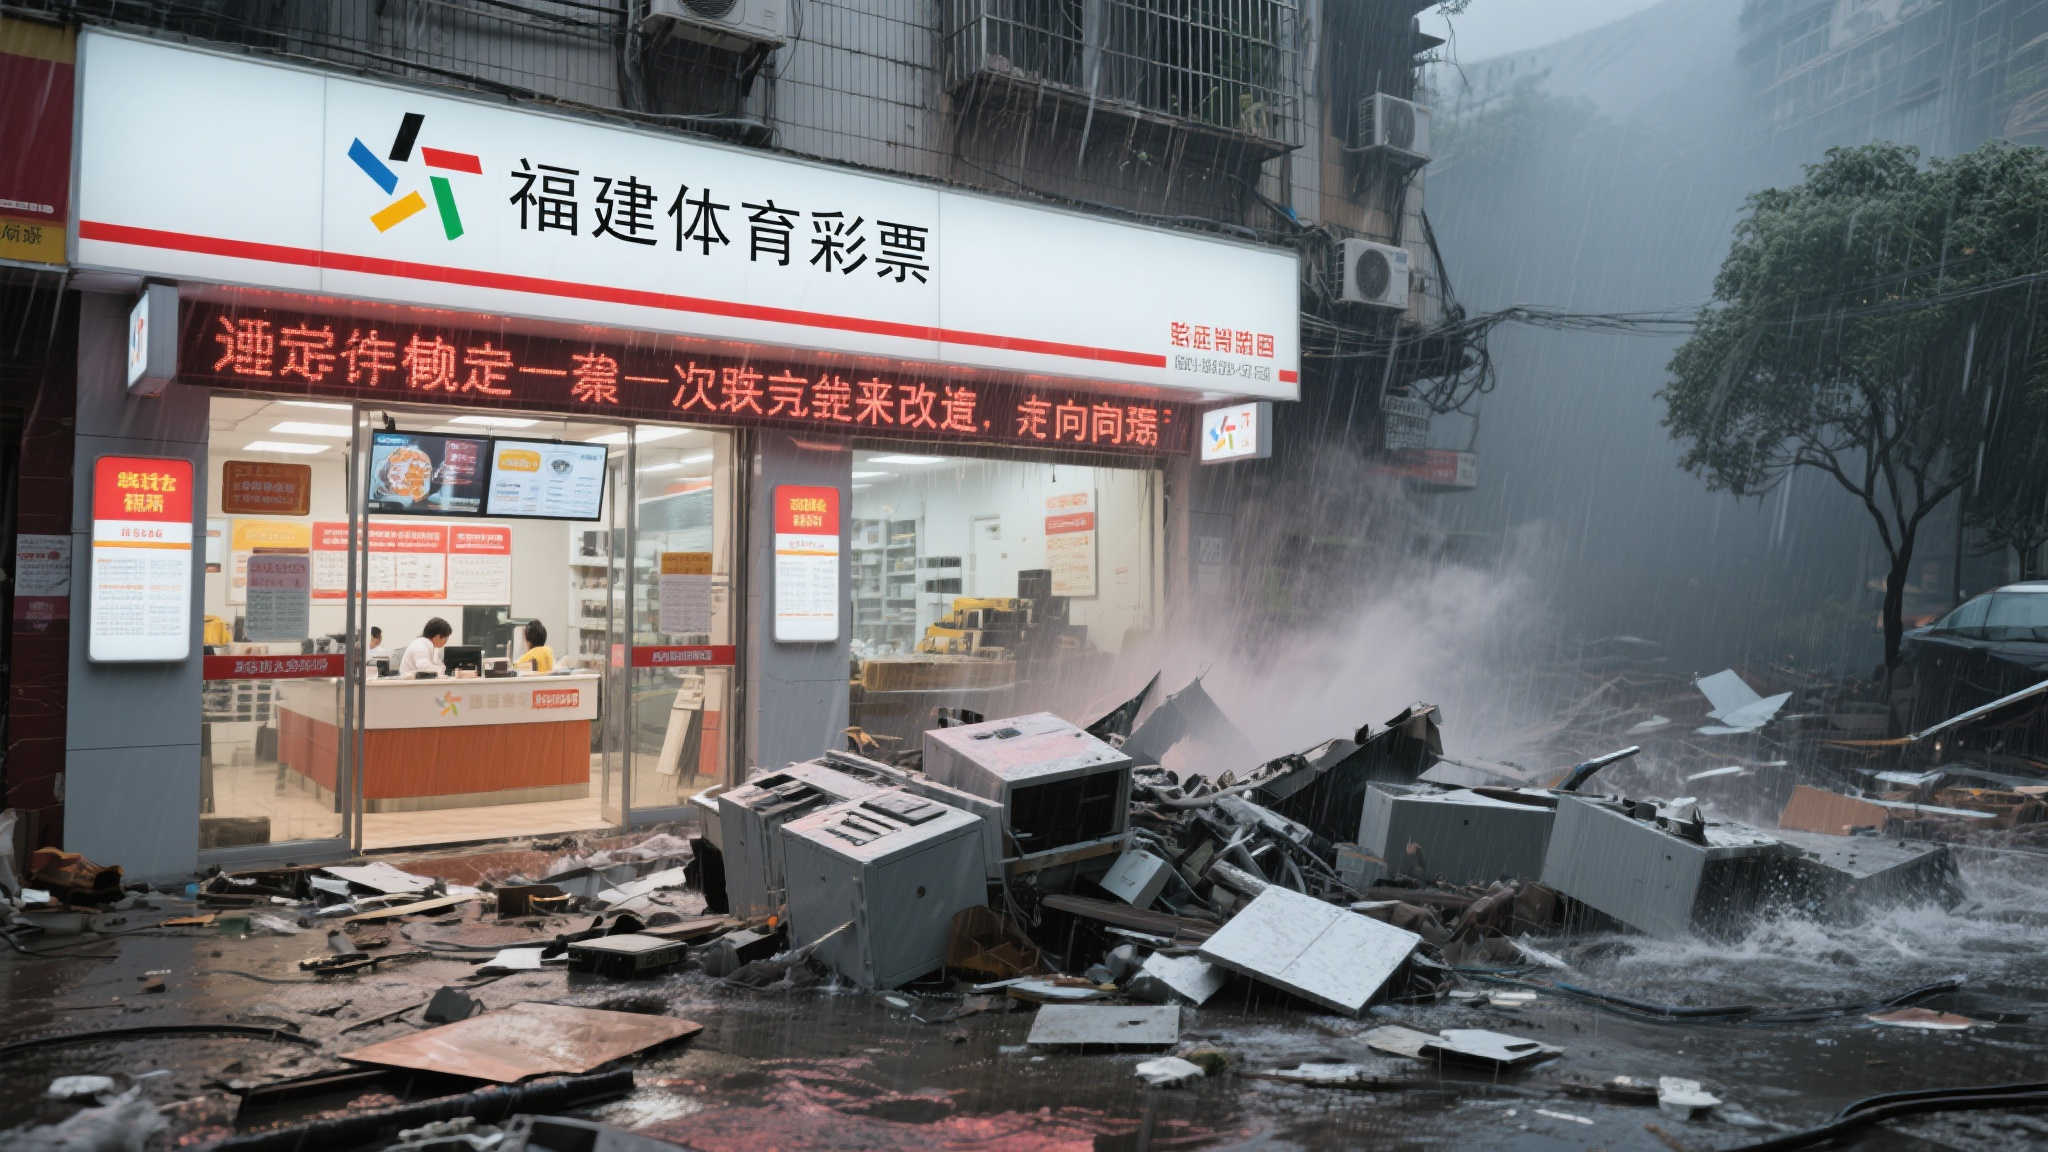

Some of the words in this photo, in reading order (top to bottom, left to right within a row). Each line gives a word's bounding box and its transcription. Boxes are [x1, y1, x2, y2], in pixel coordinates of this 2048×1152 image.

[509, 157, 930, 285] 福建体育彩票
